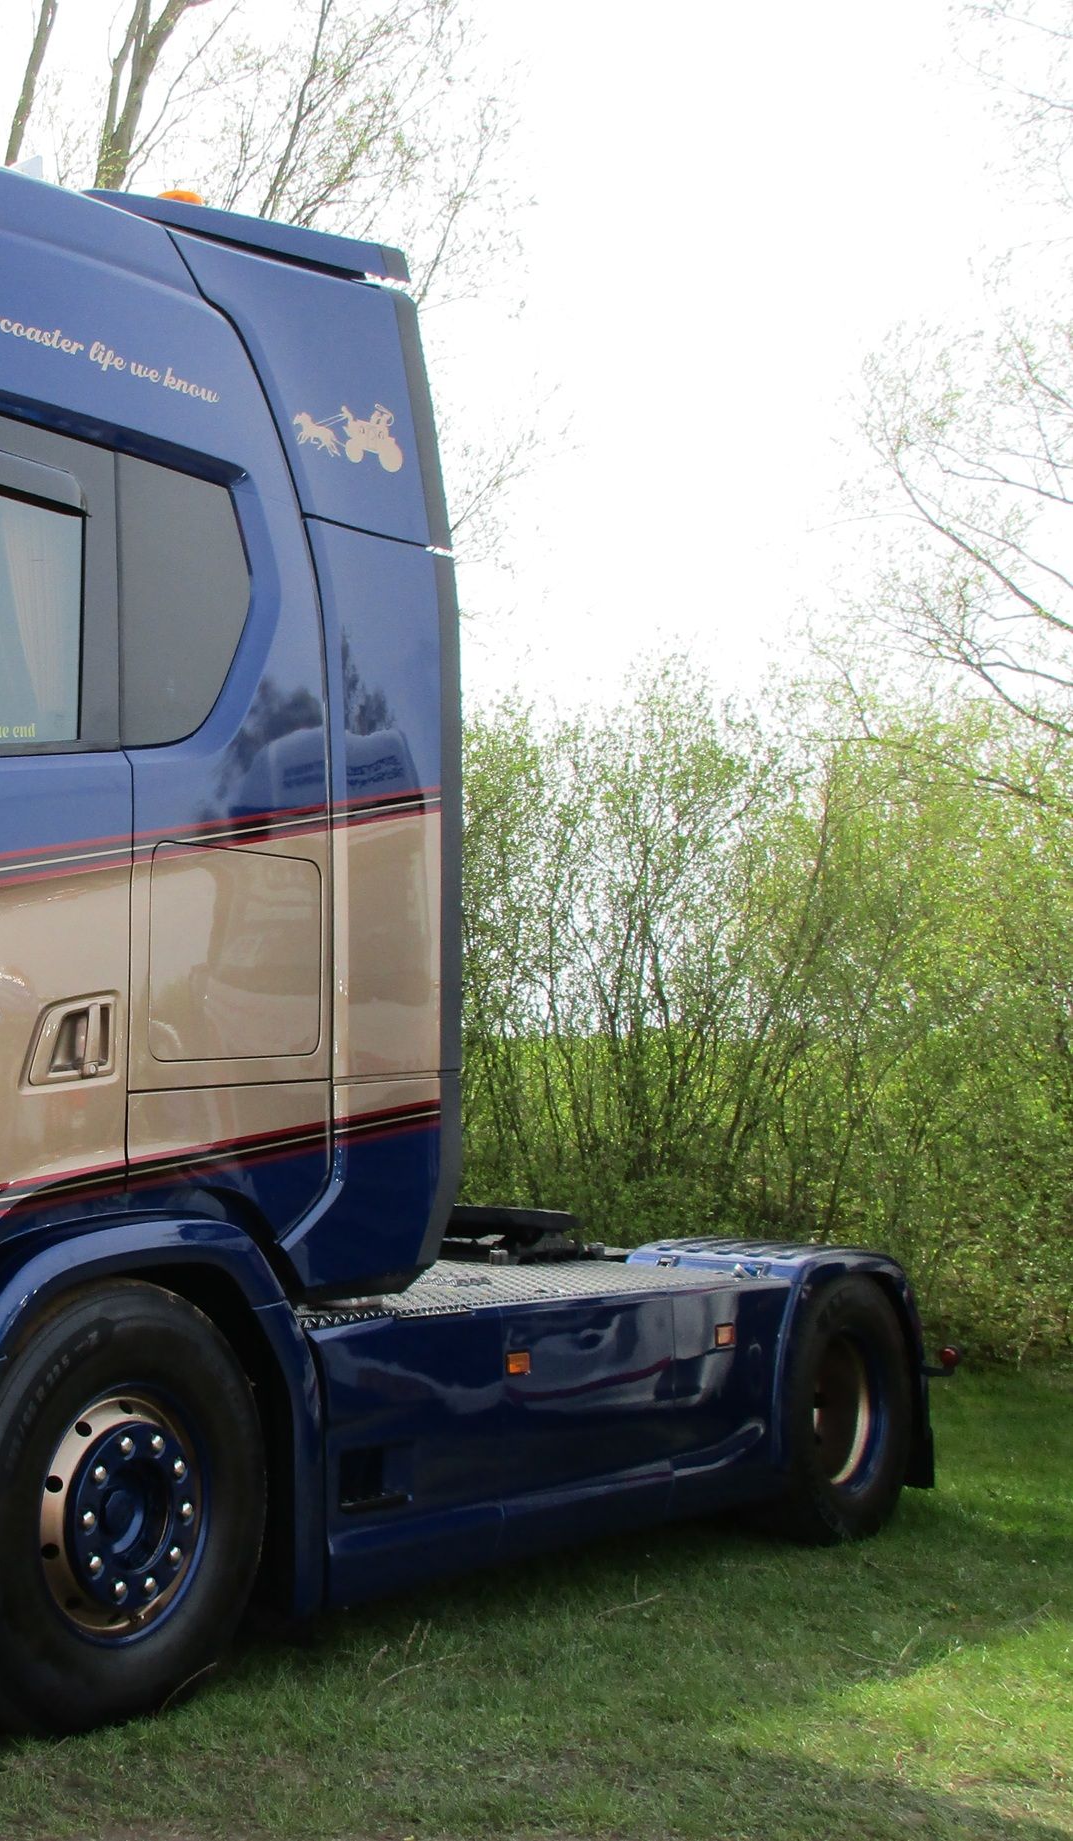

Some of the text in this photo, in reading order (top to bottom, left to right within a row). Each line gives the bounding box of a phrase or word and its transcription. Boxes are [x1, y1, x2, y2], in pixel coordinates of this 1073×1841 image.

[89, 341, 127, 371] life
[130, 361, 161, 383] we
[163, 366, 220, 403] know
[12, 723, 36, 738] end
